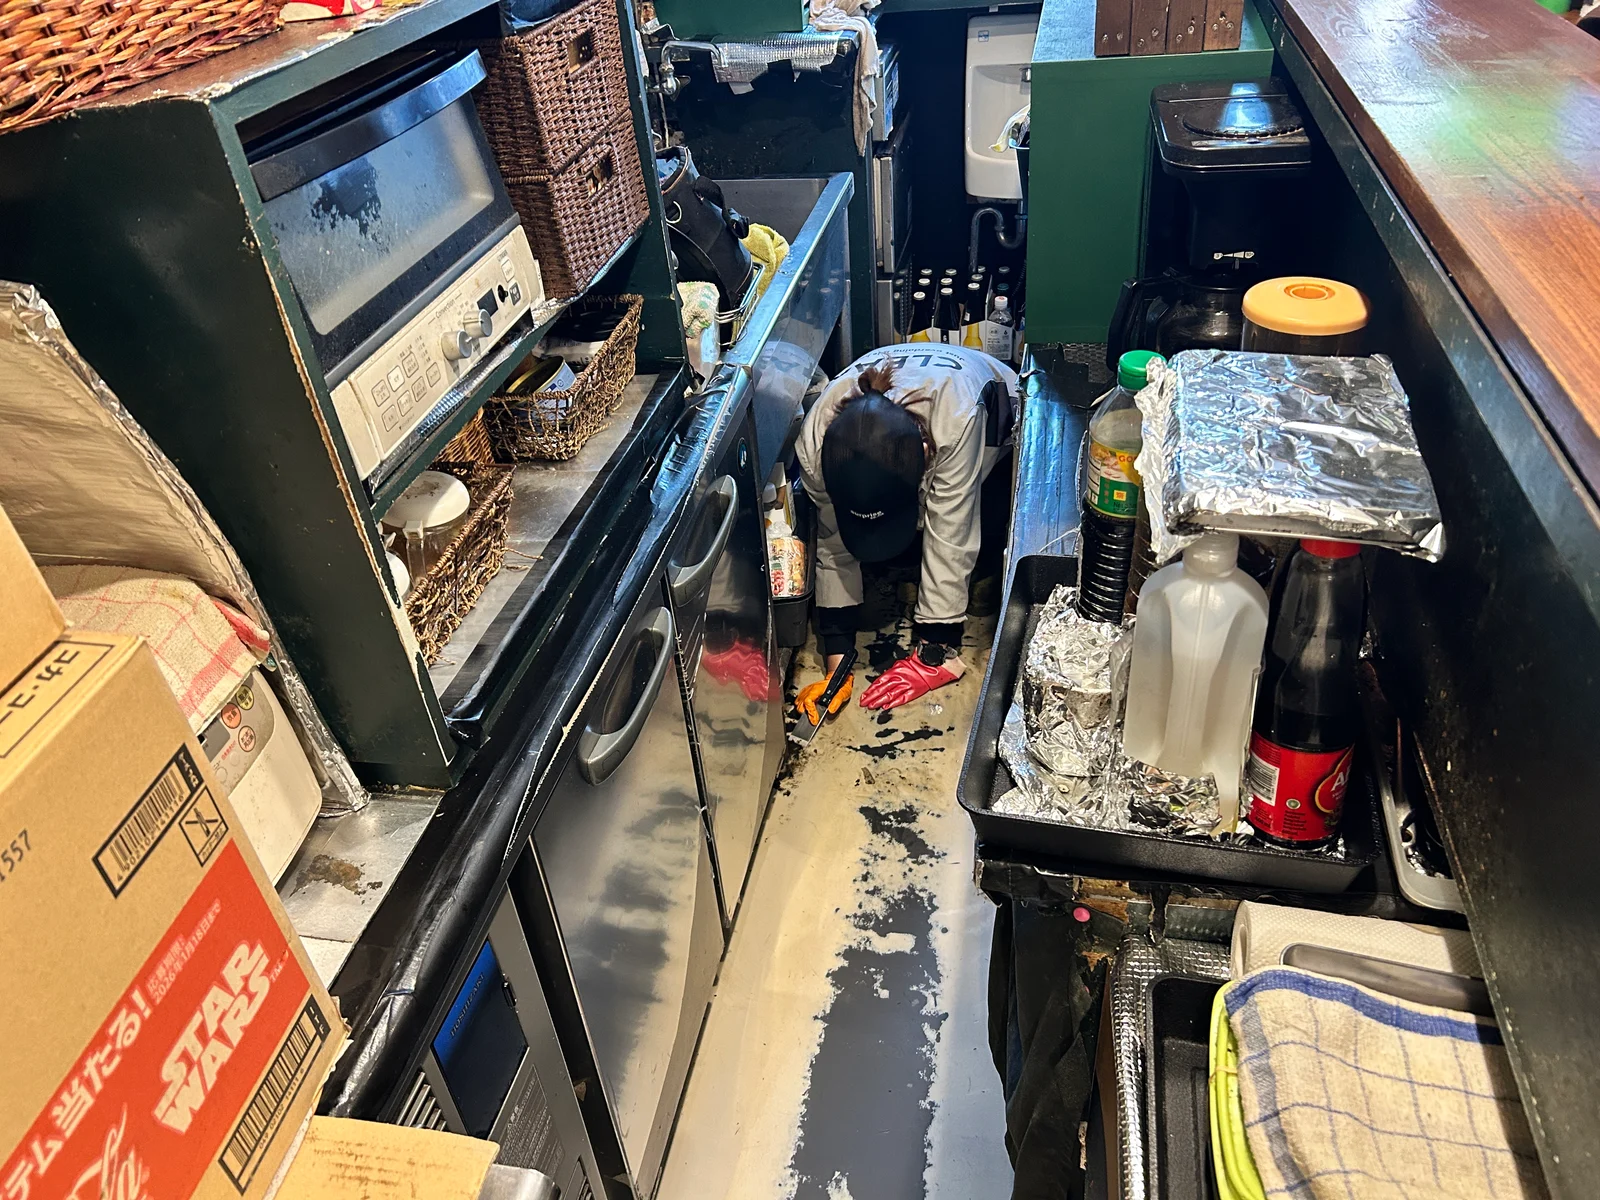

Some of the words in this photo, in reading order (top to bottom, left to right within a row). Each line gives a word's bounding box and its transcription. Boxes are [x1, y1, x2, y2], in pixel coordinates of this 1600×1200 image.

[154, 942, 270, 1118] STAR
[162, 970, 271, 1133] WARS
[451, 973, 484, 1036] HOSHIZAKI
